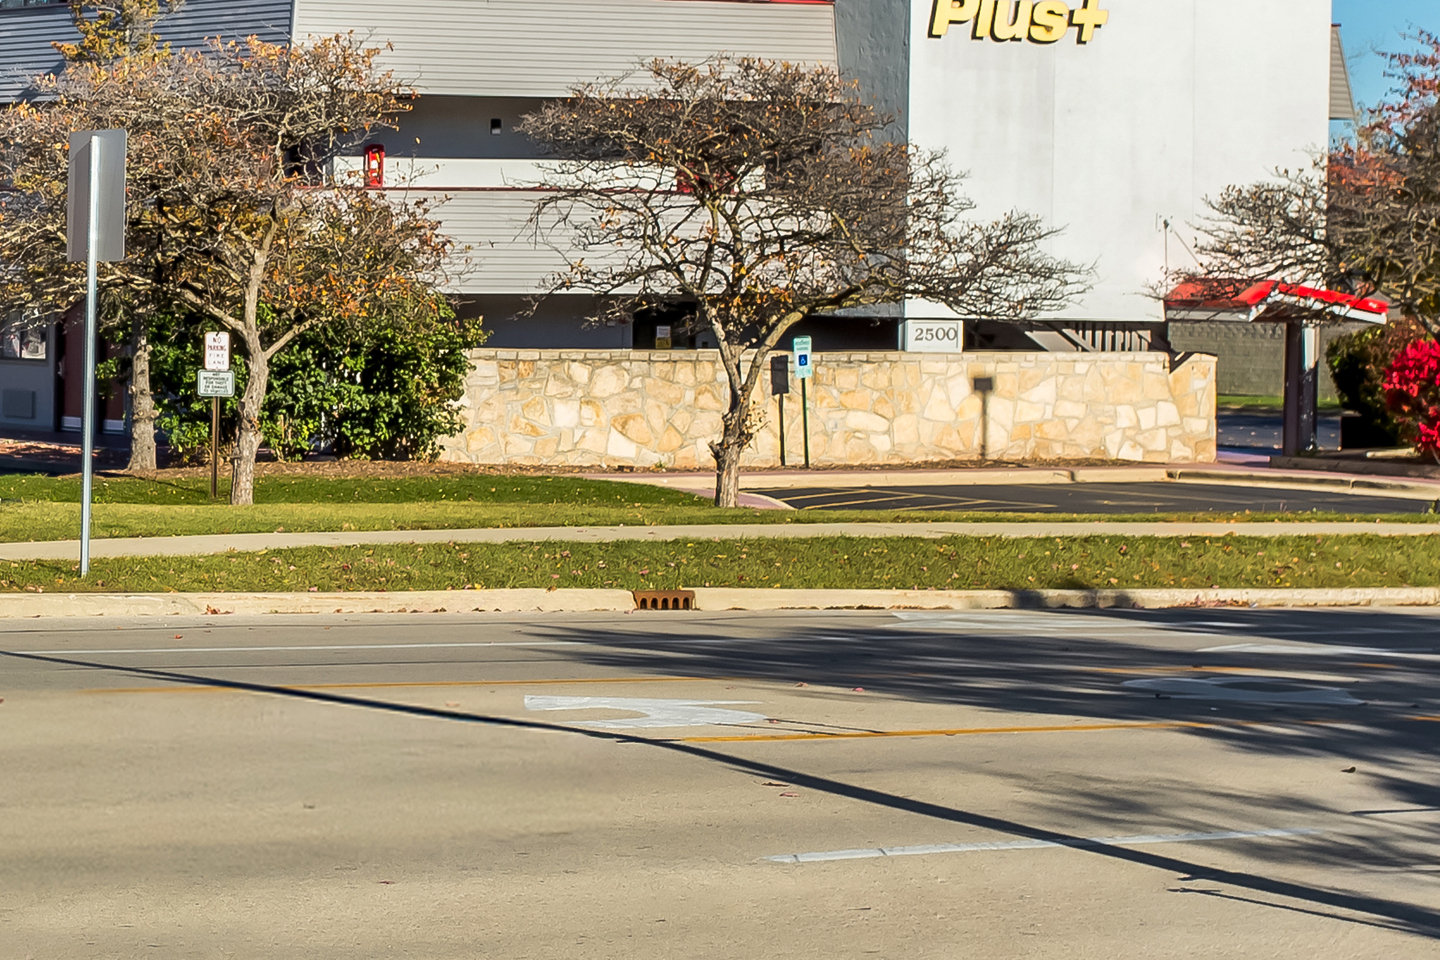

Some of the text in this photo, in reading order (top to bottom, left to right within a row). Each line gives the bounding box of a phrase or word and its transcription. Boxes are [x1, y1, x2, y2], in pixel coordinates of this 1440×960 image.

[914, 327, 957, 342] 2500
[212, 336, 222, 344] NO
[207, 344, 227, 352] PARKING
